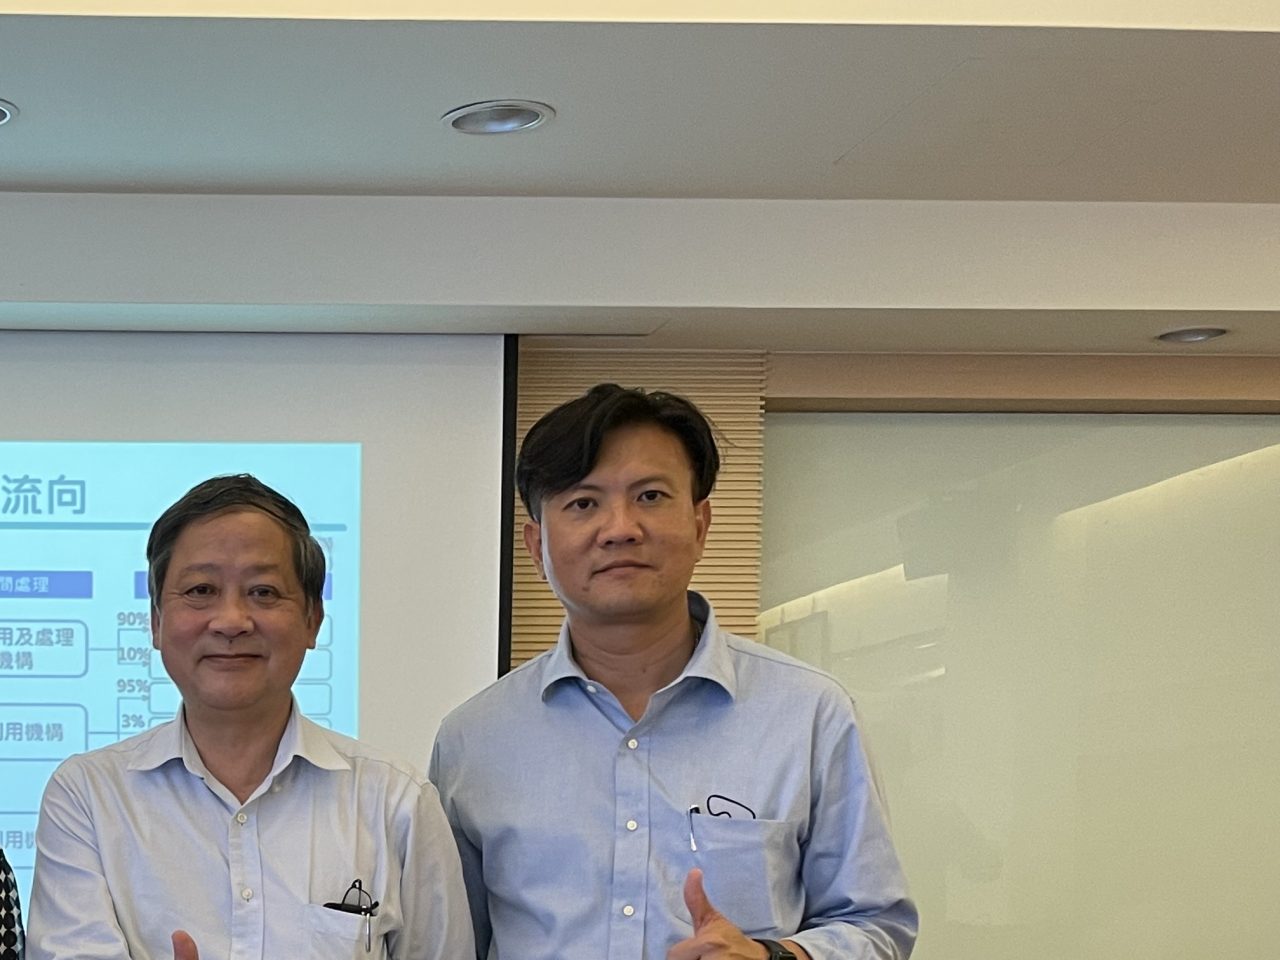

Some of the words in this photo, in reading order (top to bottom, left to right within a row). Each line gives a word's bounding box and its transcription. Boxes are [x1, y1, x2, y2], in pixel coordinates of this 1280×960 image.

[117, 612, 149, 626] 90%
[118, 647, 150, 661] 10%
[117, 679, 149, 693] 95%
[122, 714, 145, 728] 3%
